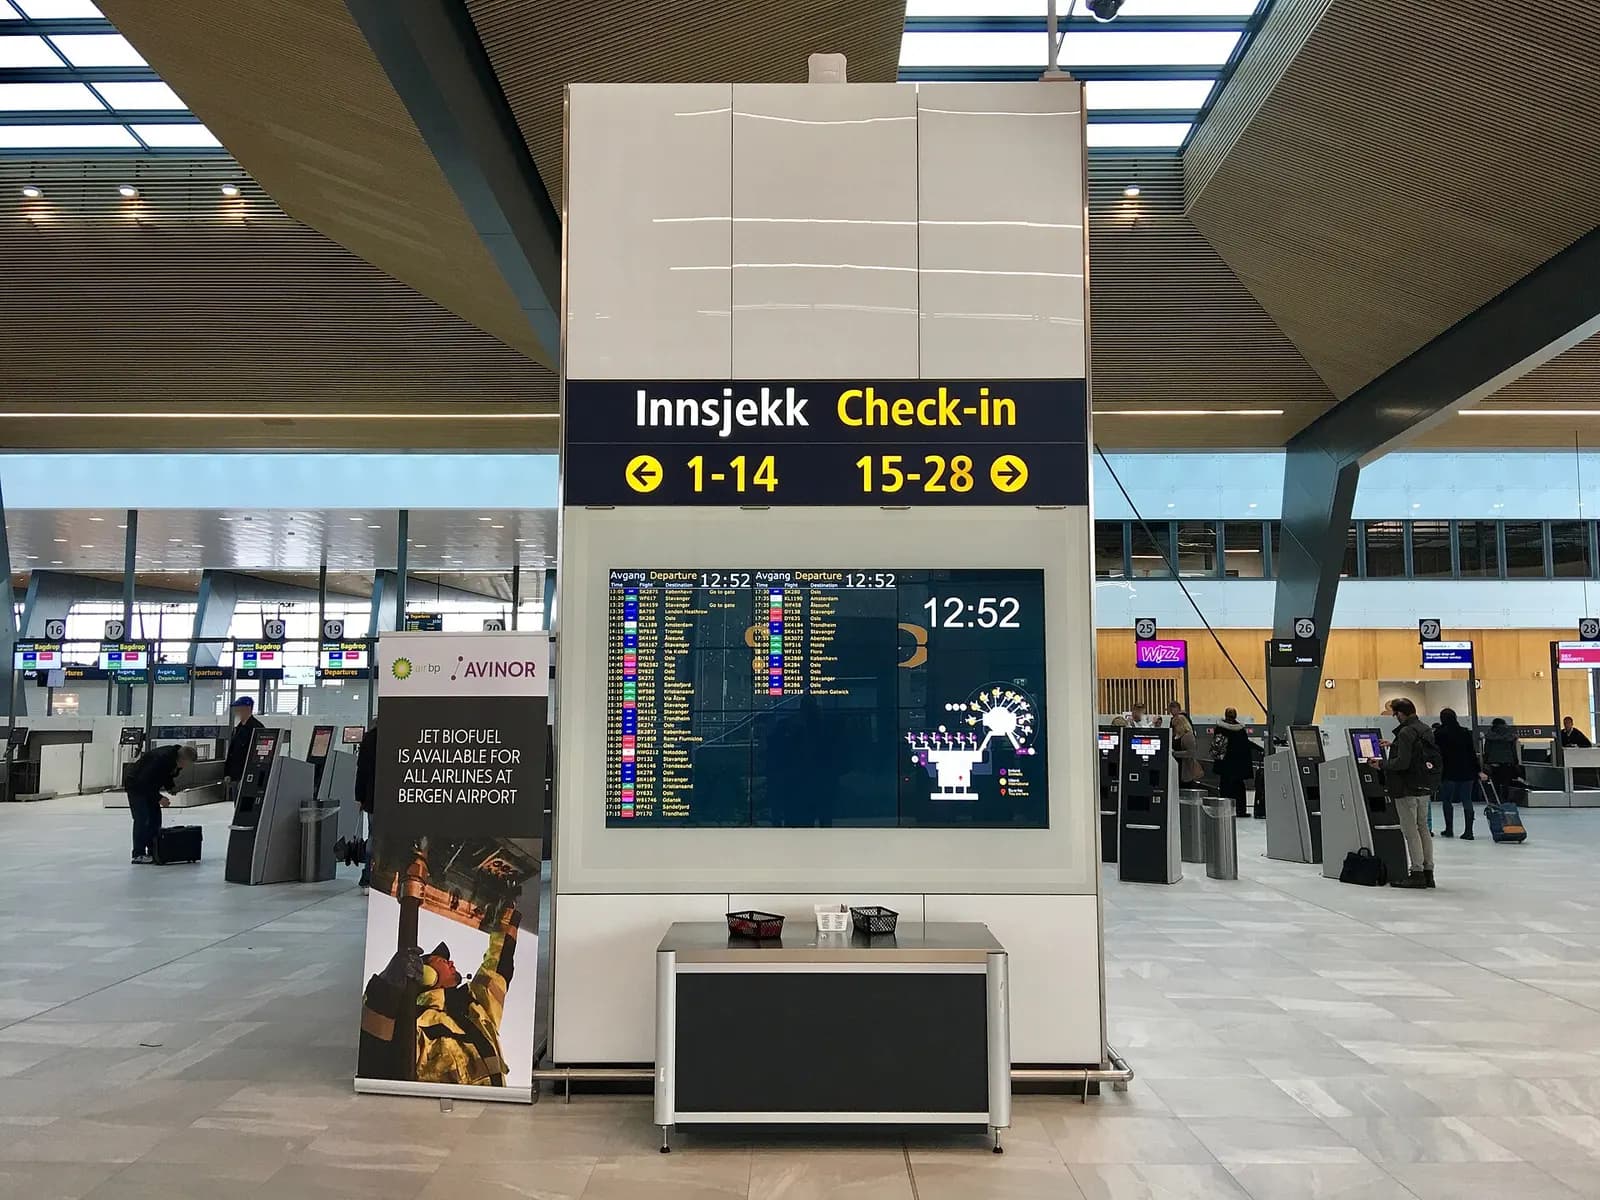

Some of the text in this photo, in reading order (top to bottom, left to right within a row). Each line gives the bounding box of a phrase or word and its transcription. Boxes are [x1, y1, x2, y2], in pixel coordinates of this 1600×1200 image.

[636, 387, 1017, 437] Innsjekk Check-in
[688, 456, 974, 493] 1-14 15-28
[611, 571, 750, 587] Avgang Departure 12:52
[756, 571, 895, 587] Avgang Departure 12:52
[924, 597, 1020, 628] 12:52
[49, 625, 62, 635] 16
[108, 625, 121, 635] 17
[269, 625, 282, 635] 18
[328, 625, 341, 635] 19
[1139, 624, 1153, 633] 25
[1298, 624, 1312, 633] 26
[1423, 625, 1437, 634] 27
[1583, 624, 1597, 634] 28
[255, 643, 280, 651] Bagdrop
[341, 643, 366, 651] Bagdrop
[464, 662, 536, 677] AVINOR
[418, 730, 501, 744] JET BIOFUEL
[398, 749, 521, 764] IS AVAILABLE FOR
[404, 769, 513, 784] ALL AIRLINES AT
[398, 788, 517, 804] BERGEN AIRPORT
